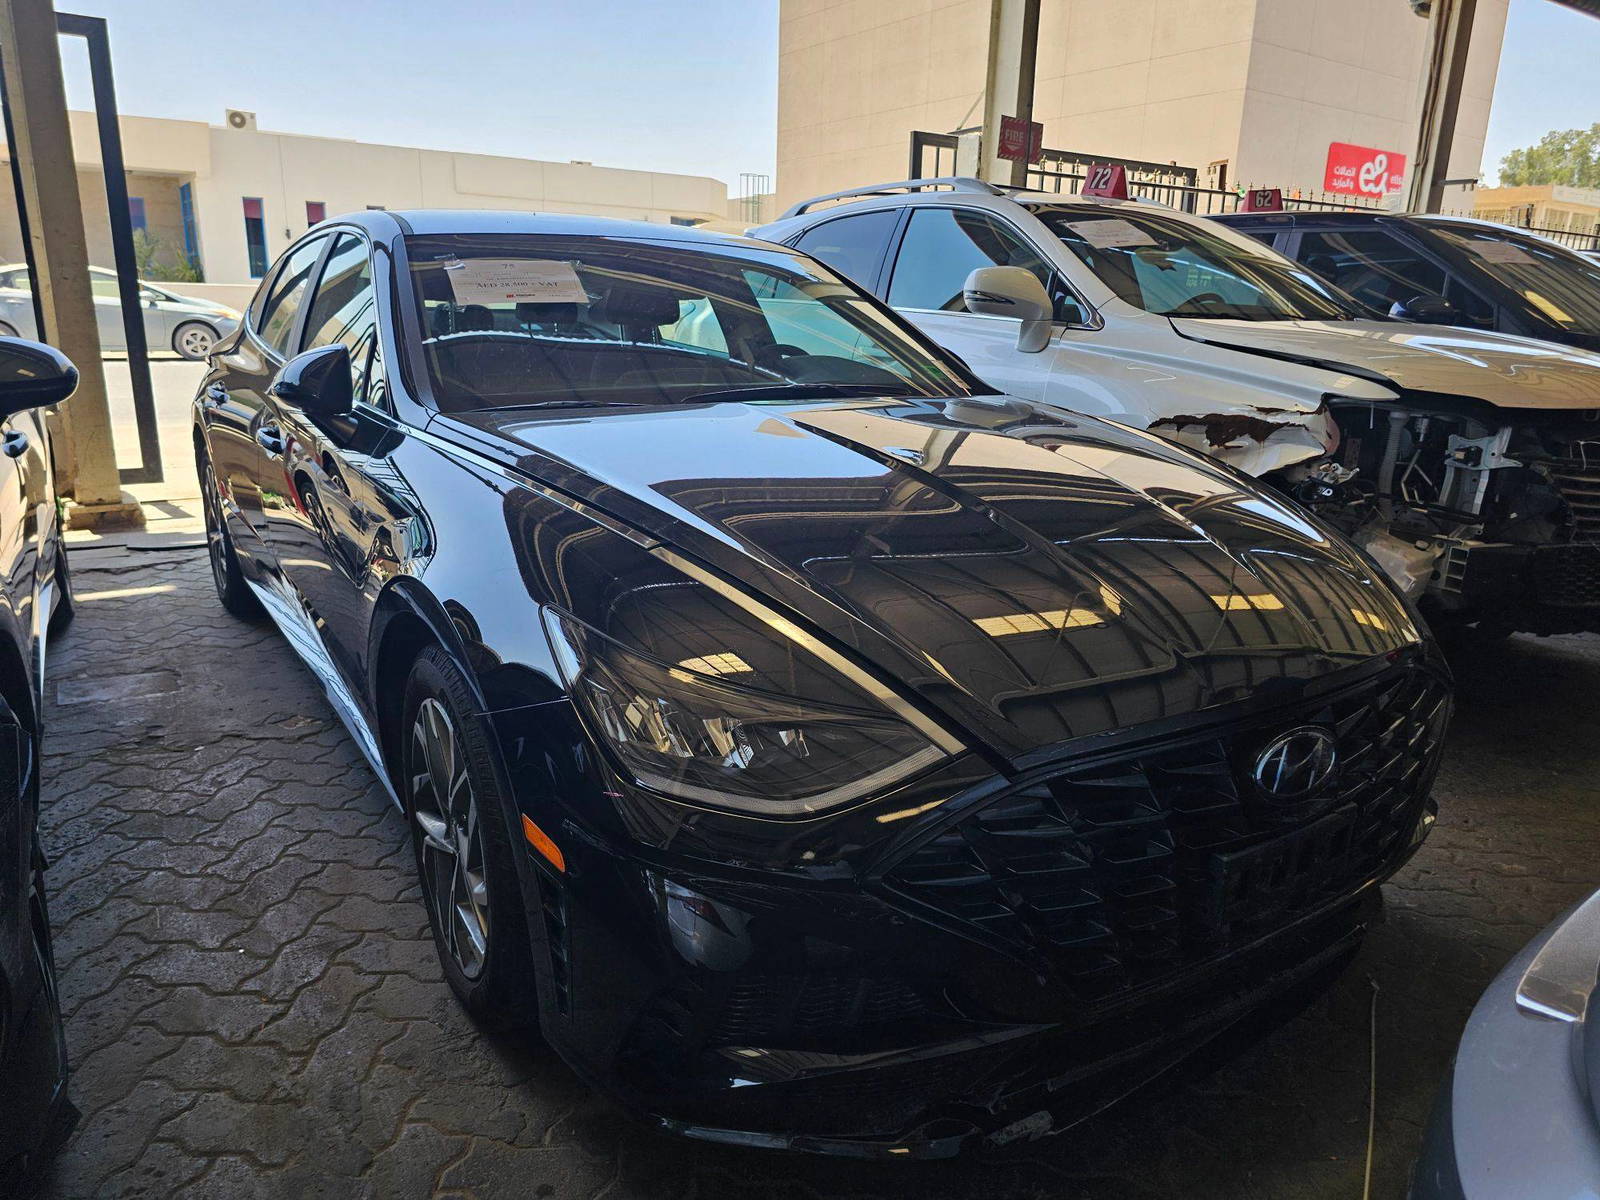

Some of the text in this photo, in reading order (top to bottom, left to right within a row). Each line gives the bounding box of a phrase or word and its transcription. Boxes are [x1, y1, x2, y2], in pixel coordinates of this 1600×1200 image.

[1005, 129, 1024, 143] FIRE
[1089, 167, 1112, 190] 72
[1255, 190, 1273, 208] 62
